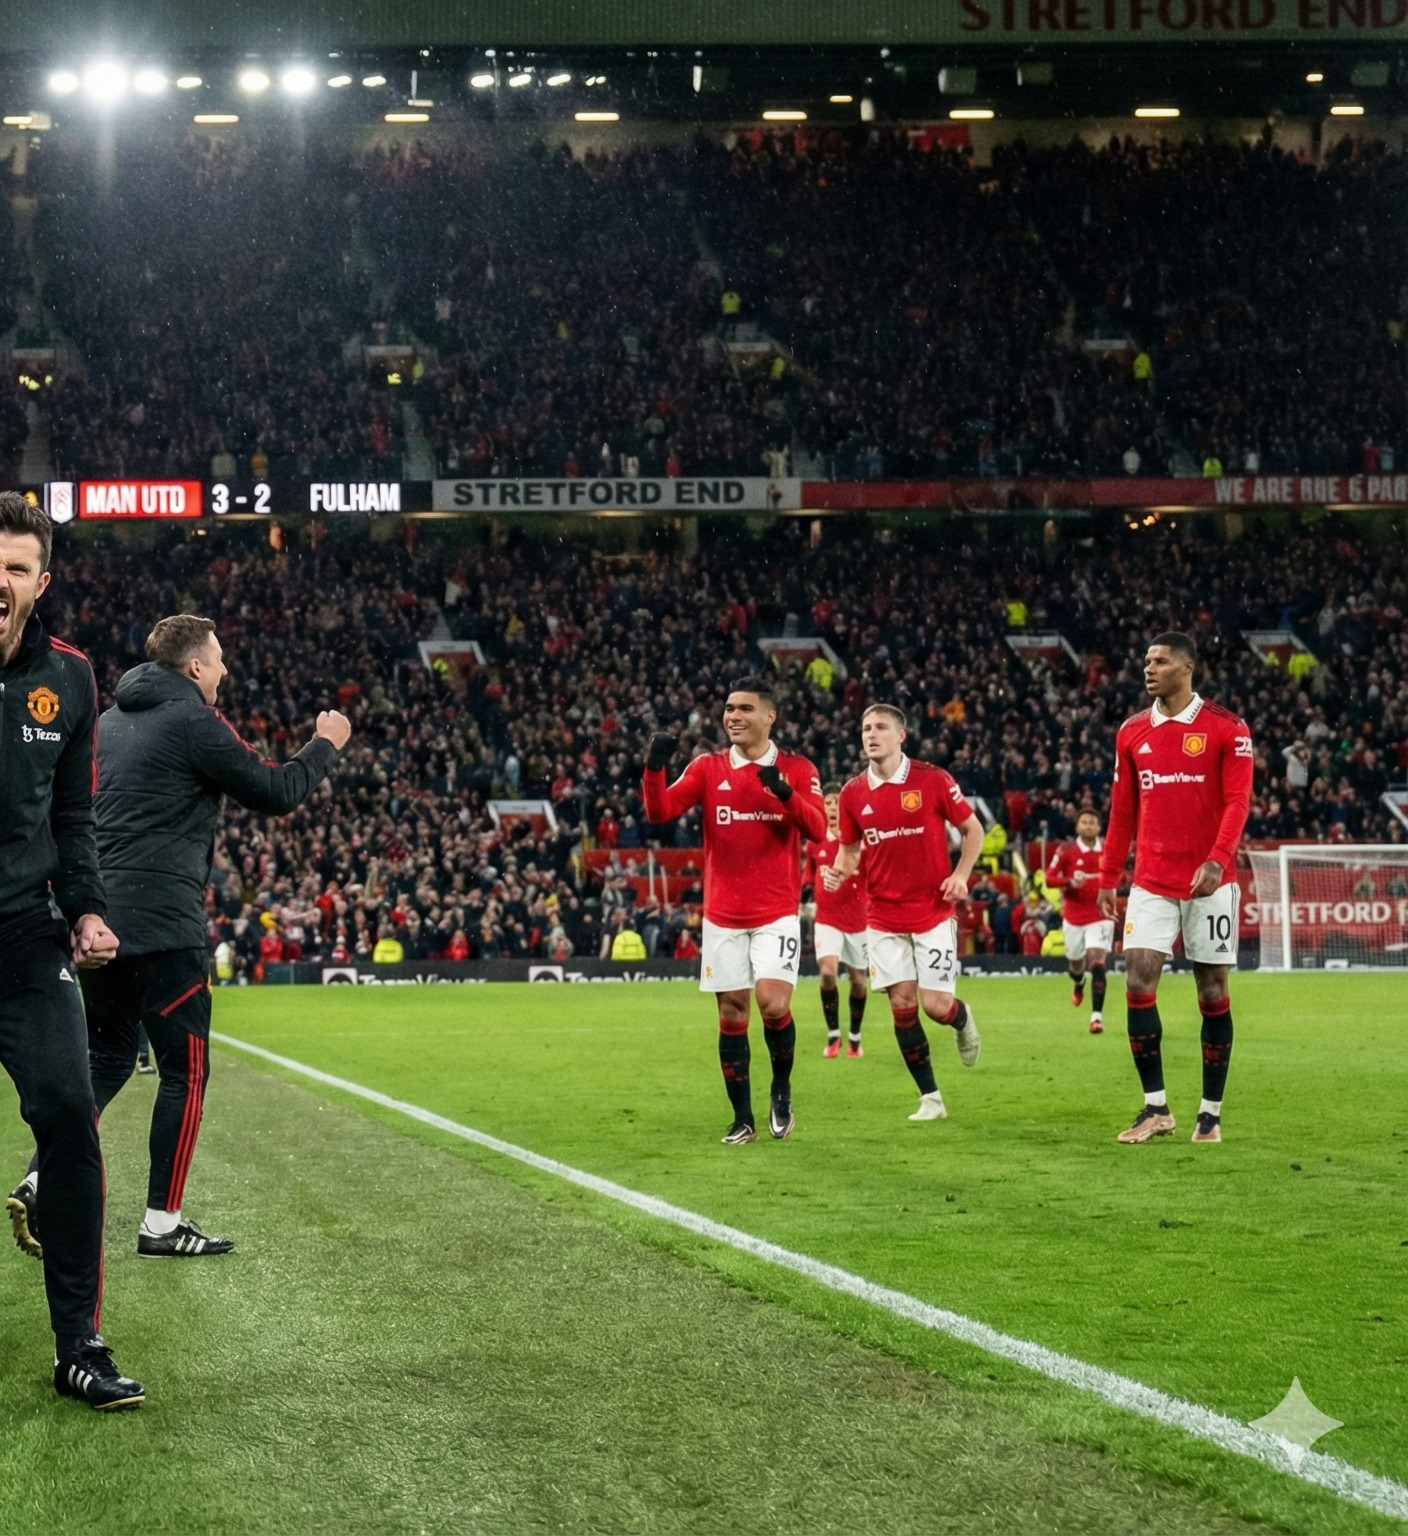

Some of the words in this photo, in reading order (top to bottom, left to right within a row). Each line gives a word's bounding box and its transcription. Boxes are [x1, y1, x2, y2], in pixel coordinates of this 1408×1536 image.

[960, 0, 1275, 31] STRETFORD
[1298, 0, 1408, 30] END
[86, 485, 137, 514] MAN
[142, 485, 186, 514] UTD
[212, 484, 229, 514] 3
[254, 483, 272, 513] 2
[309, 483, 401, 512] FULHAM
[453, 482, 662, 506] STRETFORD
[675, 481, 745, 505] END
[1207, 914, 1231, 941] 10
[778, 935, 798, 959] 19
[928, 948, 953, 971] 25
